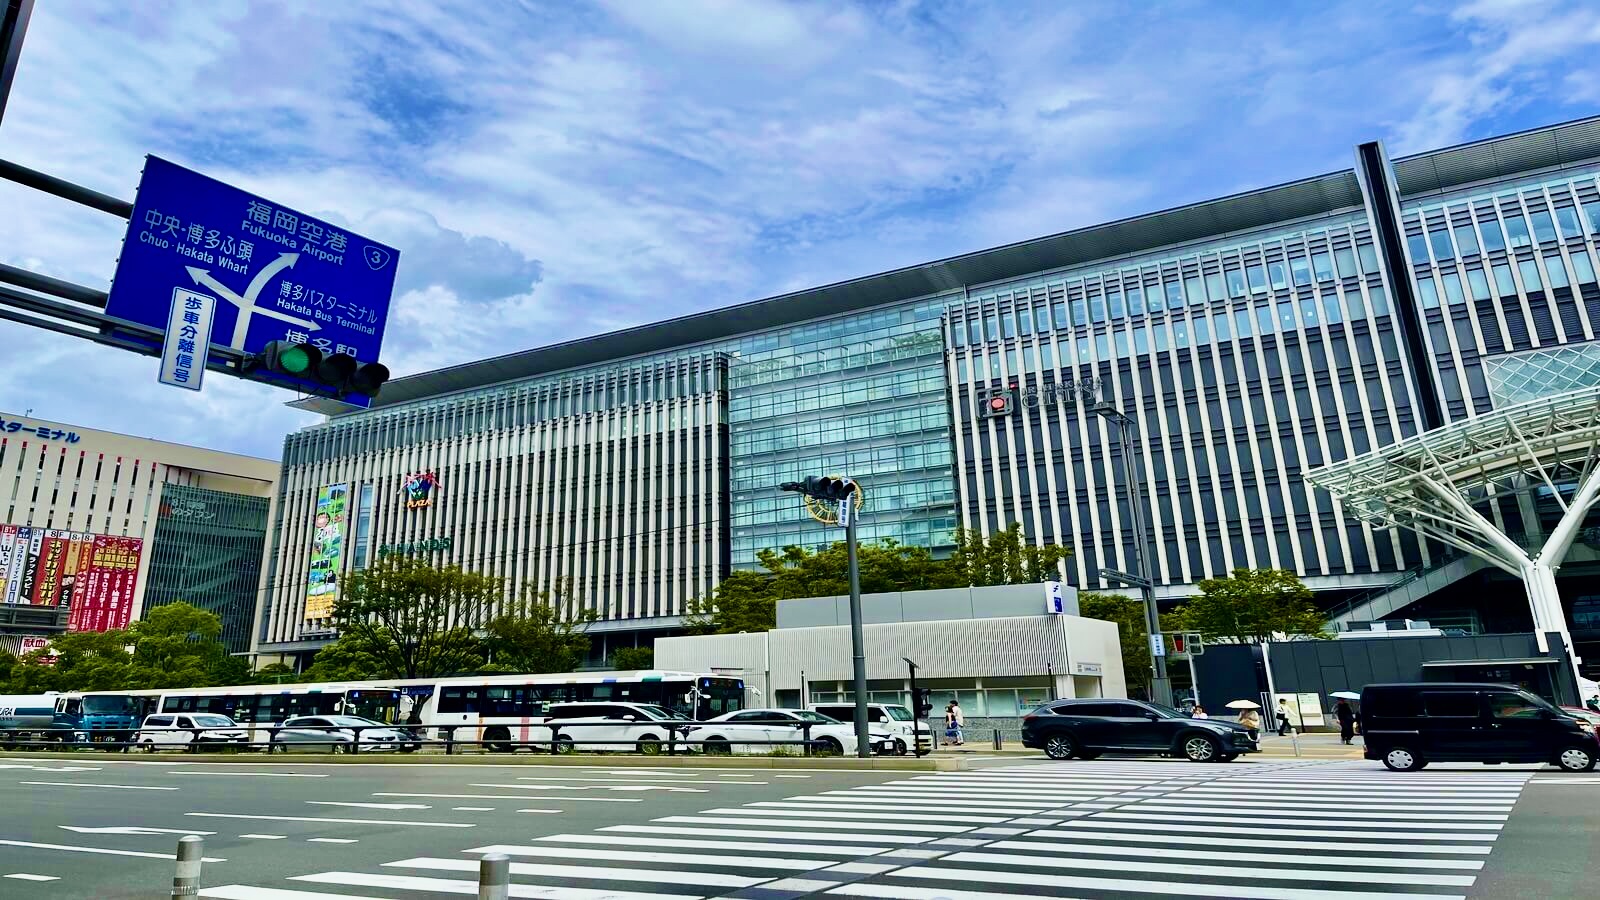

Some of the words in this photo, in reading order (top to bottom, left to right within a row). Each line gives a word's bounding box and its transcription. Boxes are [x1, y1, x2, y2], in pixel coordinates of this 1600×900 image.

[241, 219, 298, 249] Fukuoka
[301, 240, 345, 266] Airport
[246, 199, 348, 254] 福岡空港
[371, 250, 381, 264] 3
[277, 297, 312, 317] Hakata
[314, 308, 332, 323] Bus
[336, 314, 376, 336] Terminal
[280, 279, 378, 325] 博多バスターミナル
[173, 295, 203, 384] 歩車分離信号
